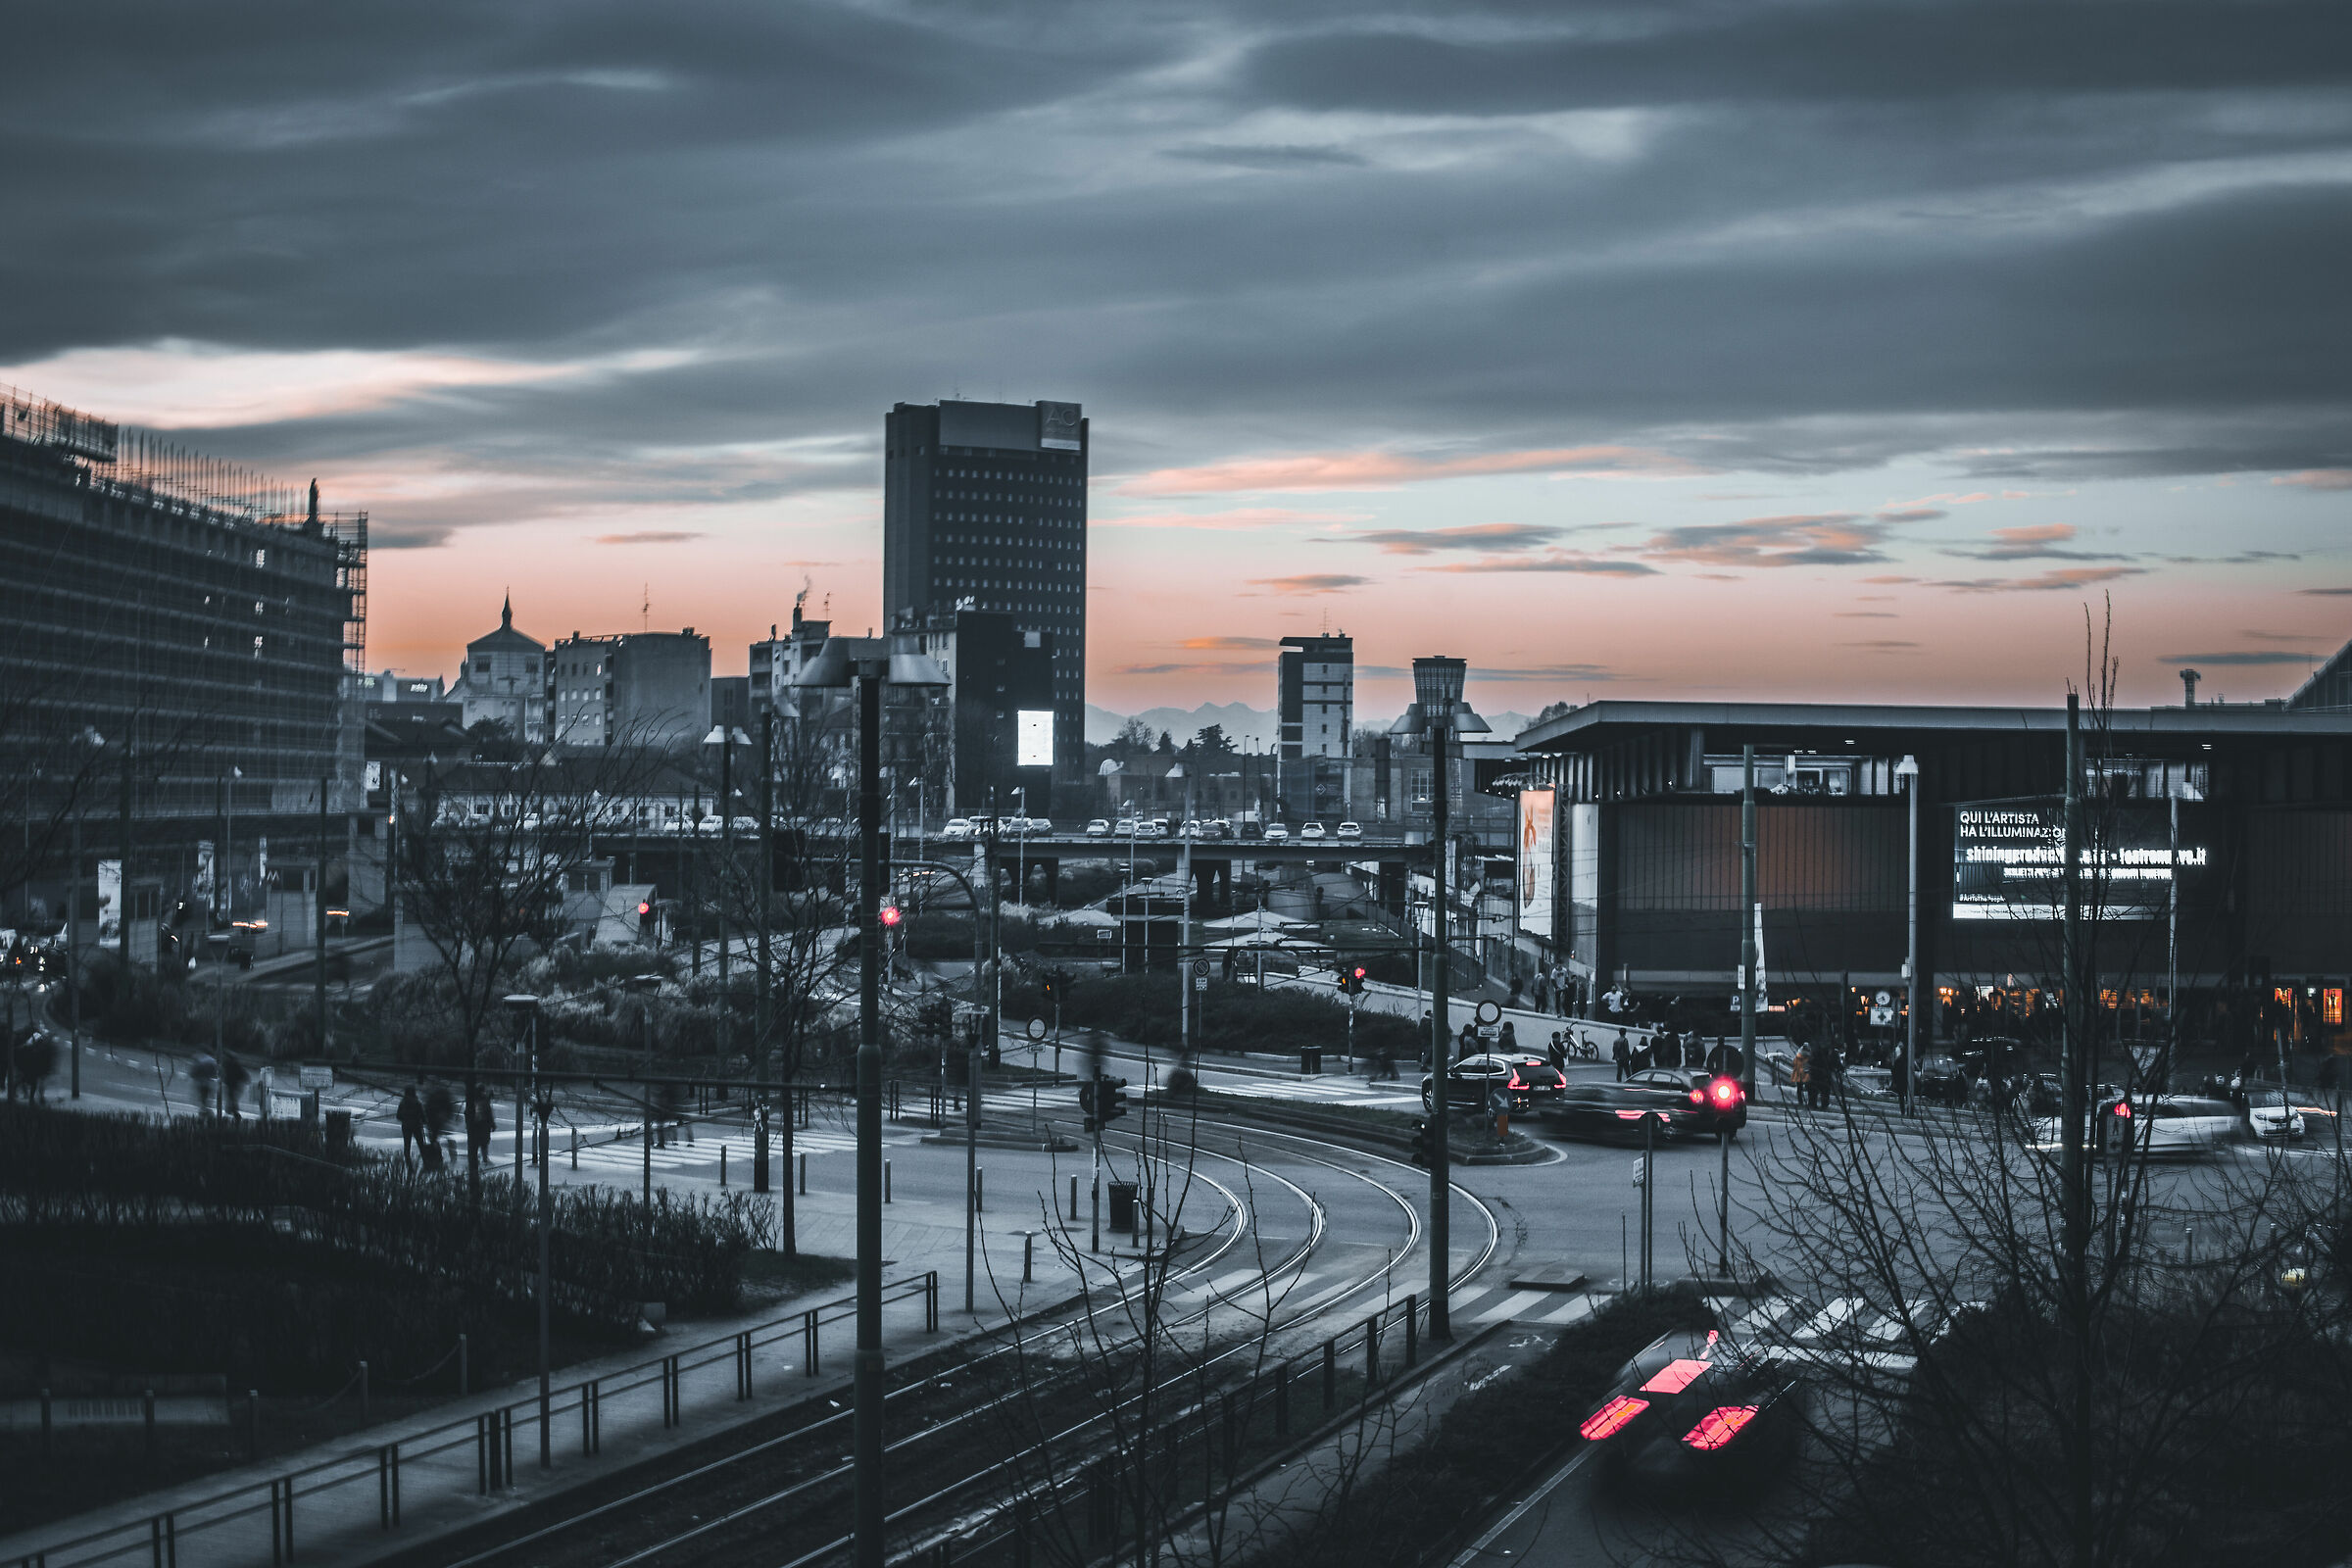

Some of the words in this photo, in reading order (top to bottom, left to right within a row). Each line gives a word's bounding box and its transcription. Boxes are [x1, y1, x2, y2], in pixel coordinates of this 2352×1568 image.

[1044, 408, 1076, 426] AC
[1960, 810, 1982, 824] QUI
[1984, 811, 2039, 825] L'ARTISTA
[1960, 825, 1977, 837] HA
[1733, 995, 1740, 1004] P
